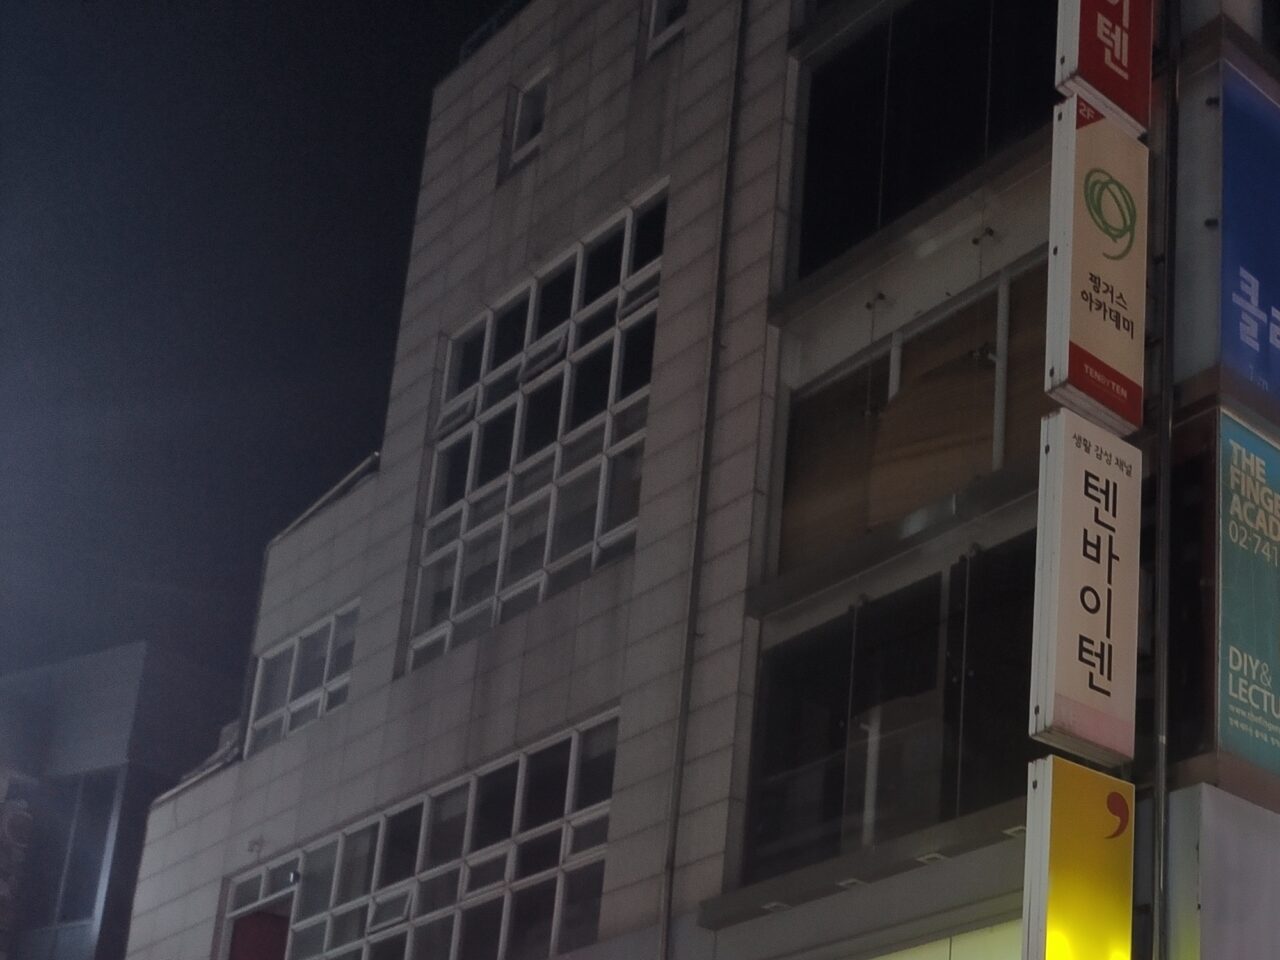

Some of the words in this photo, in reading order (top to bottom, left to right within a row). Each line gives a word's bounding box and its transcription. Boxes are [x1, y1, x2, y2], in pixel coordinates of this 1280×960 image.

[1079, 103, 1095, 119] 2F
[1088, 272, 1128, 310] 핑거스
[1080, 290, 1134, 340] 아카데미
[1095, 443, 1114, 466] 감성
[1229, 438, 1267, 484] THE
[1078, 469, 1120, 698] 텐바이텐
